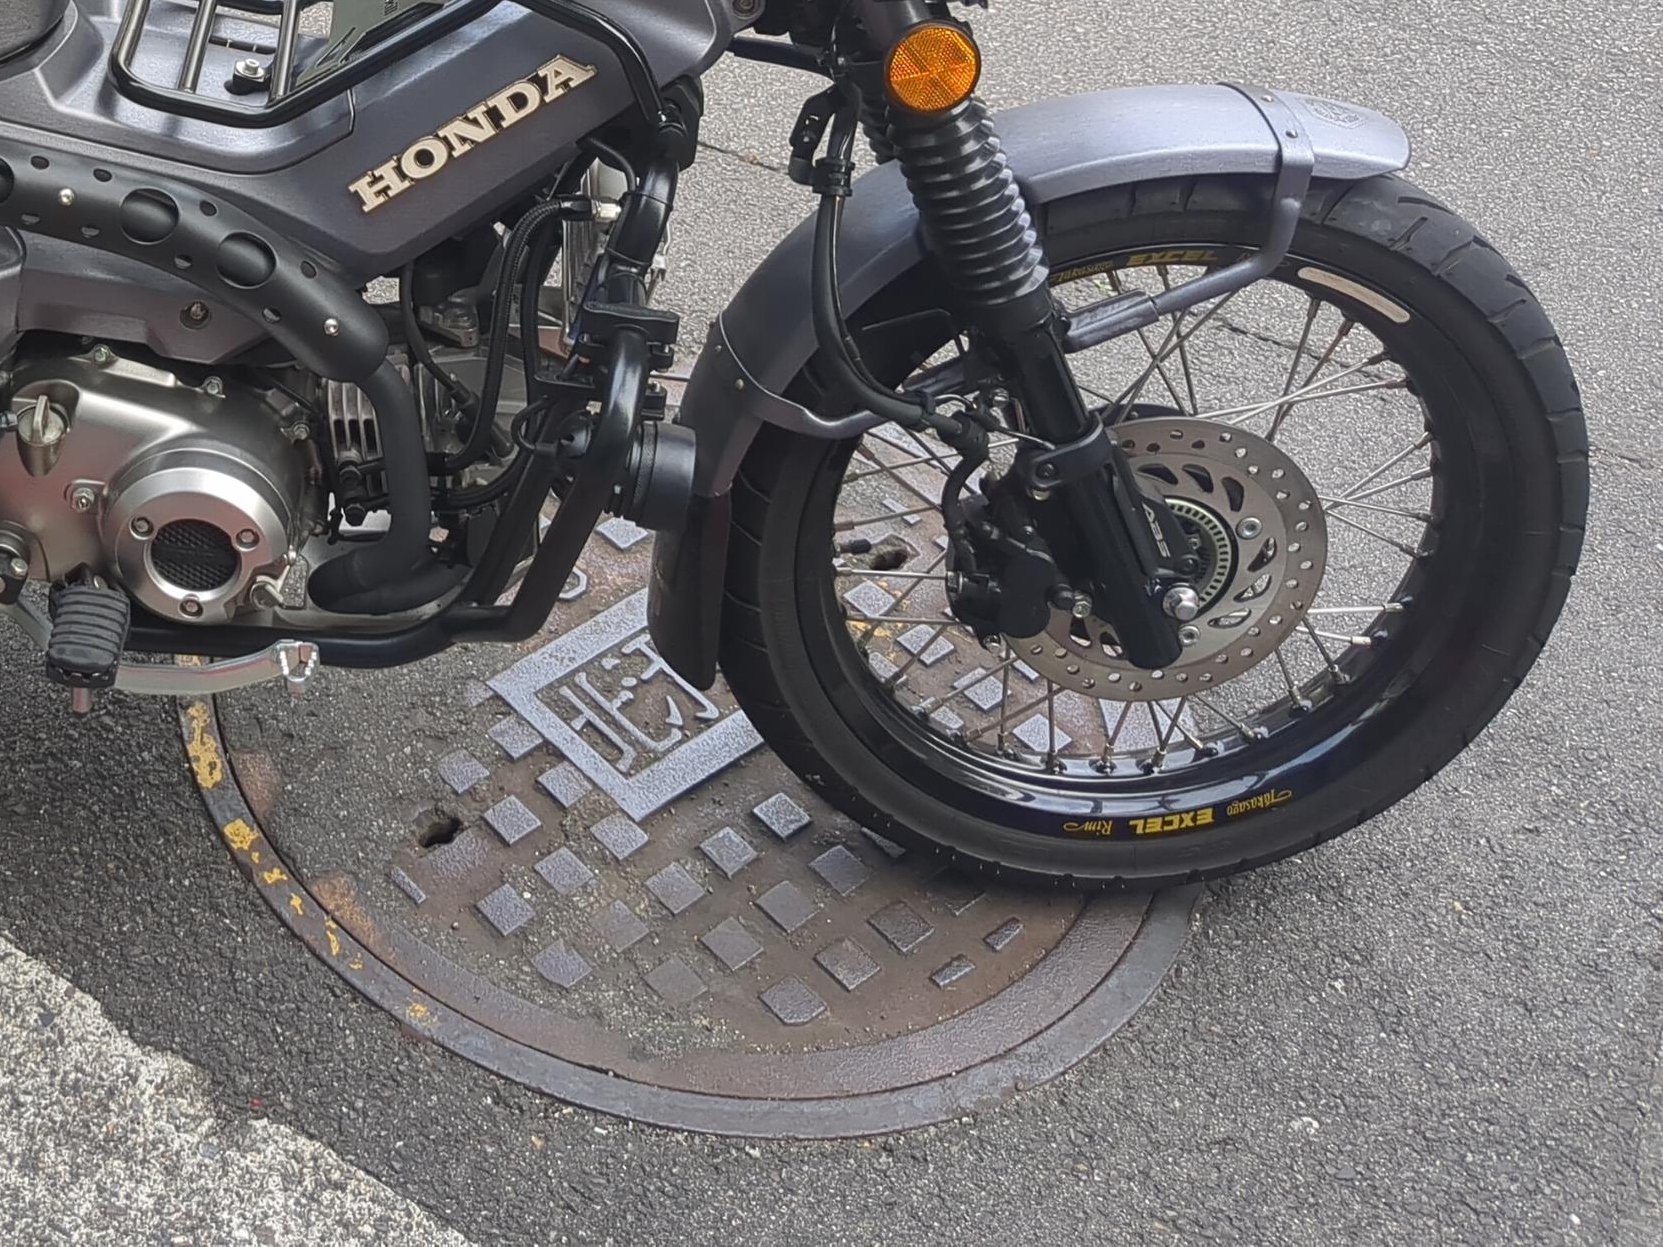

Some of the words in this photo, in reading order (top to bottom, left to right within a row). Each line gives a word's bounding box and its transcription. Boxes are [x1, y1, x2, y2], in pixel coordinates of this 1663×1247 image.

[347, 54, 597, 215] HONDA
[1128, 250, 1218, 267] EXCEL
[1141, 501, 1172, 558] ABS
[1225, 788, 1293, 817] Takasago
[1128, 806, 1215, 836] EXCEL
